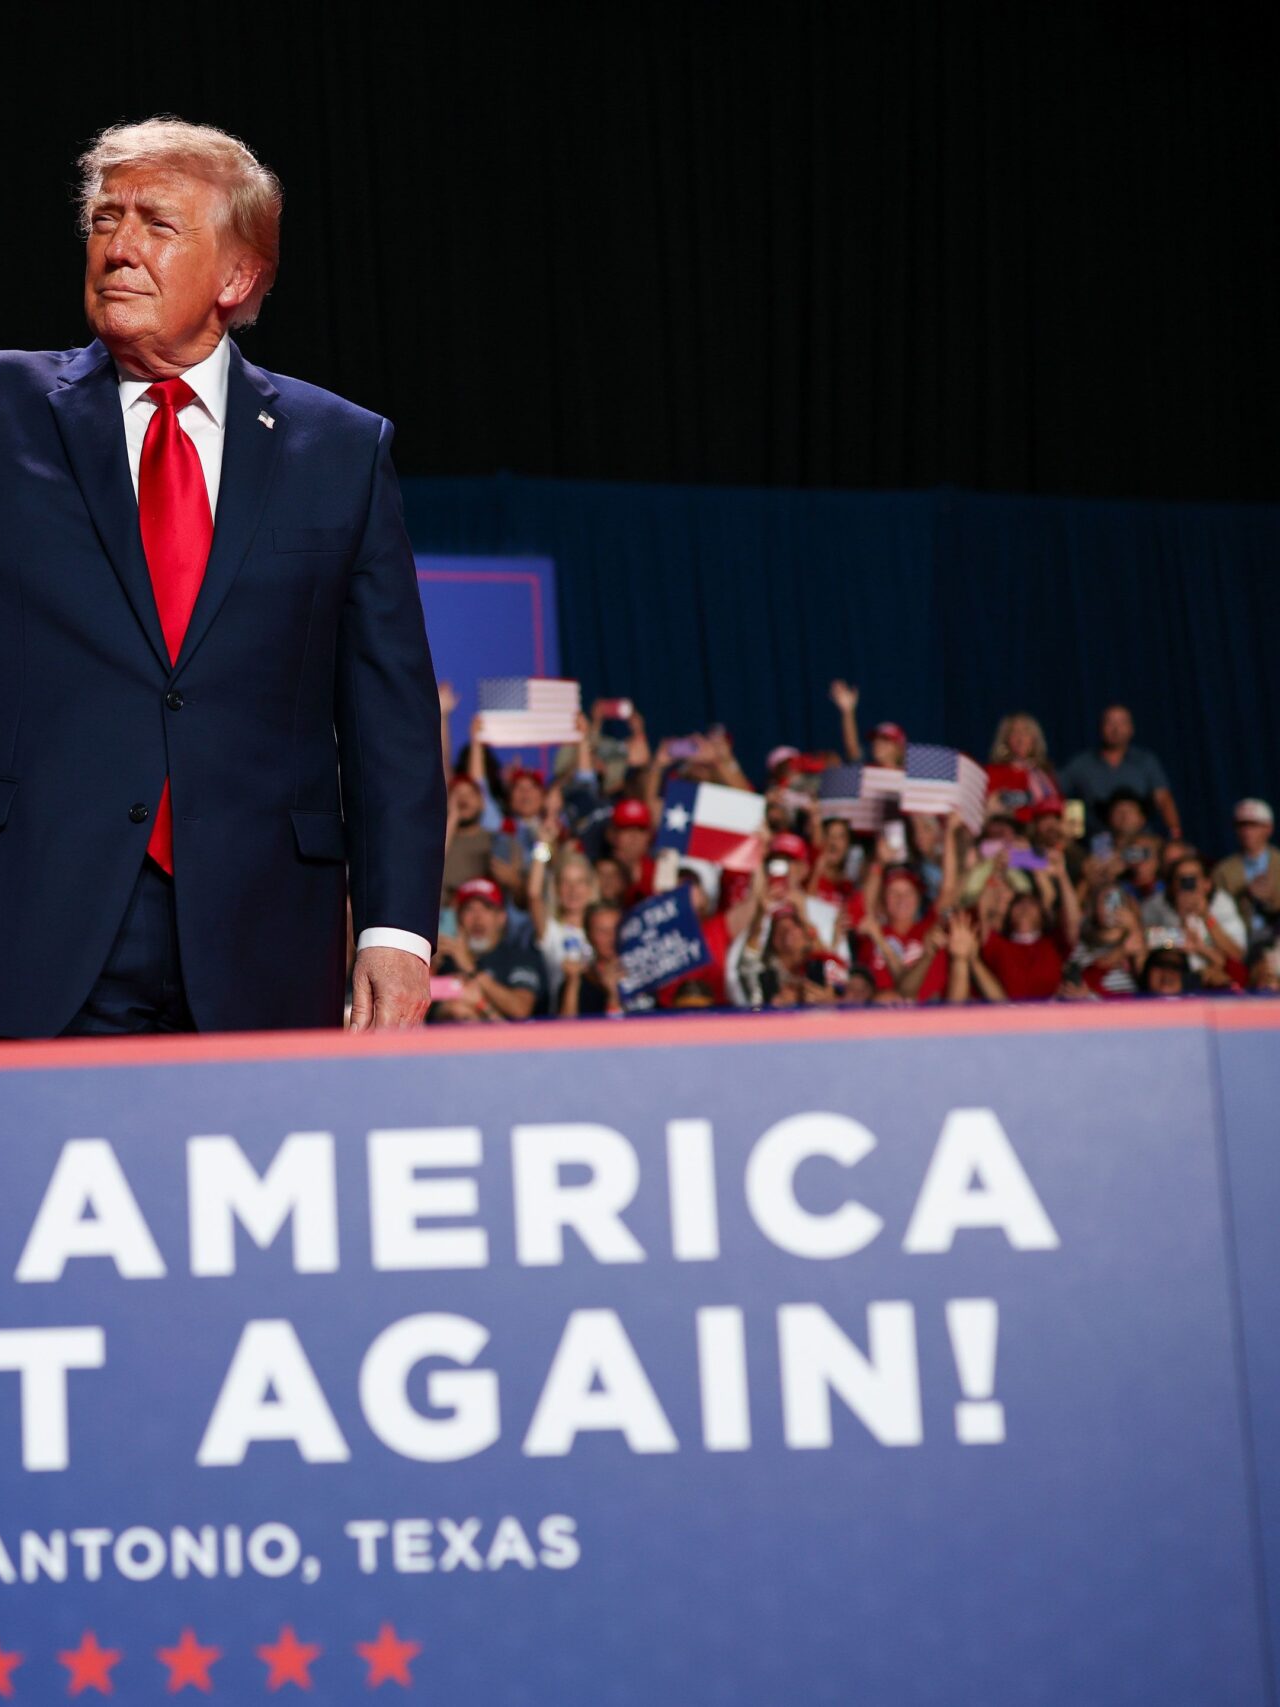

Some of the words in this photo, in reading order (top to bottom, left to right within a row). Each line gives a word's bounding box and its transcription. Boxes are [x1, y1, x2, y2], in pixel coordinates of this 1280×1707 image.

[14, 1107, 1061, 1284] AMERICA
[196, 1295, 1008, 1468] AGAIN!
[344, 1513, 582, 1575] TEXAS
